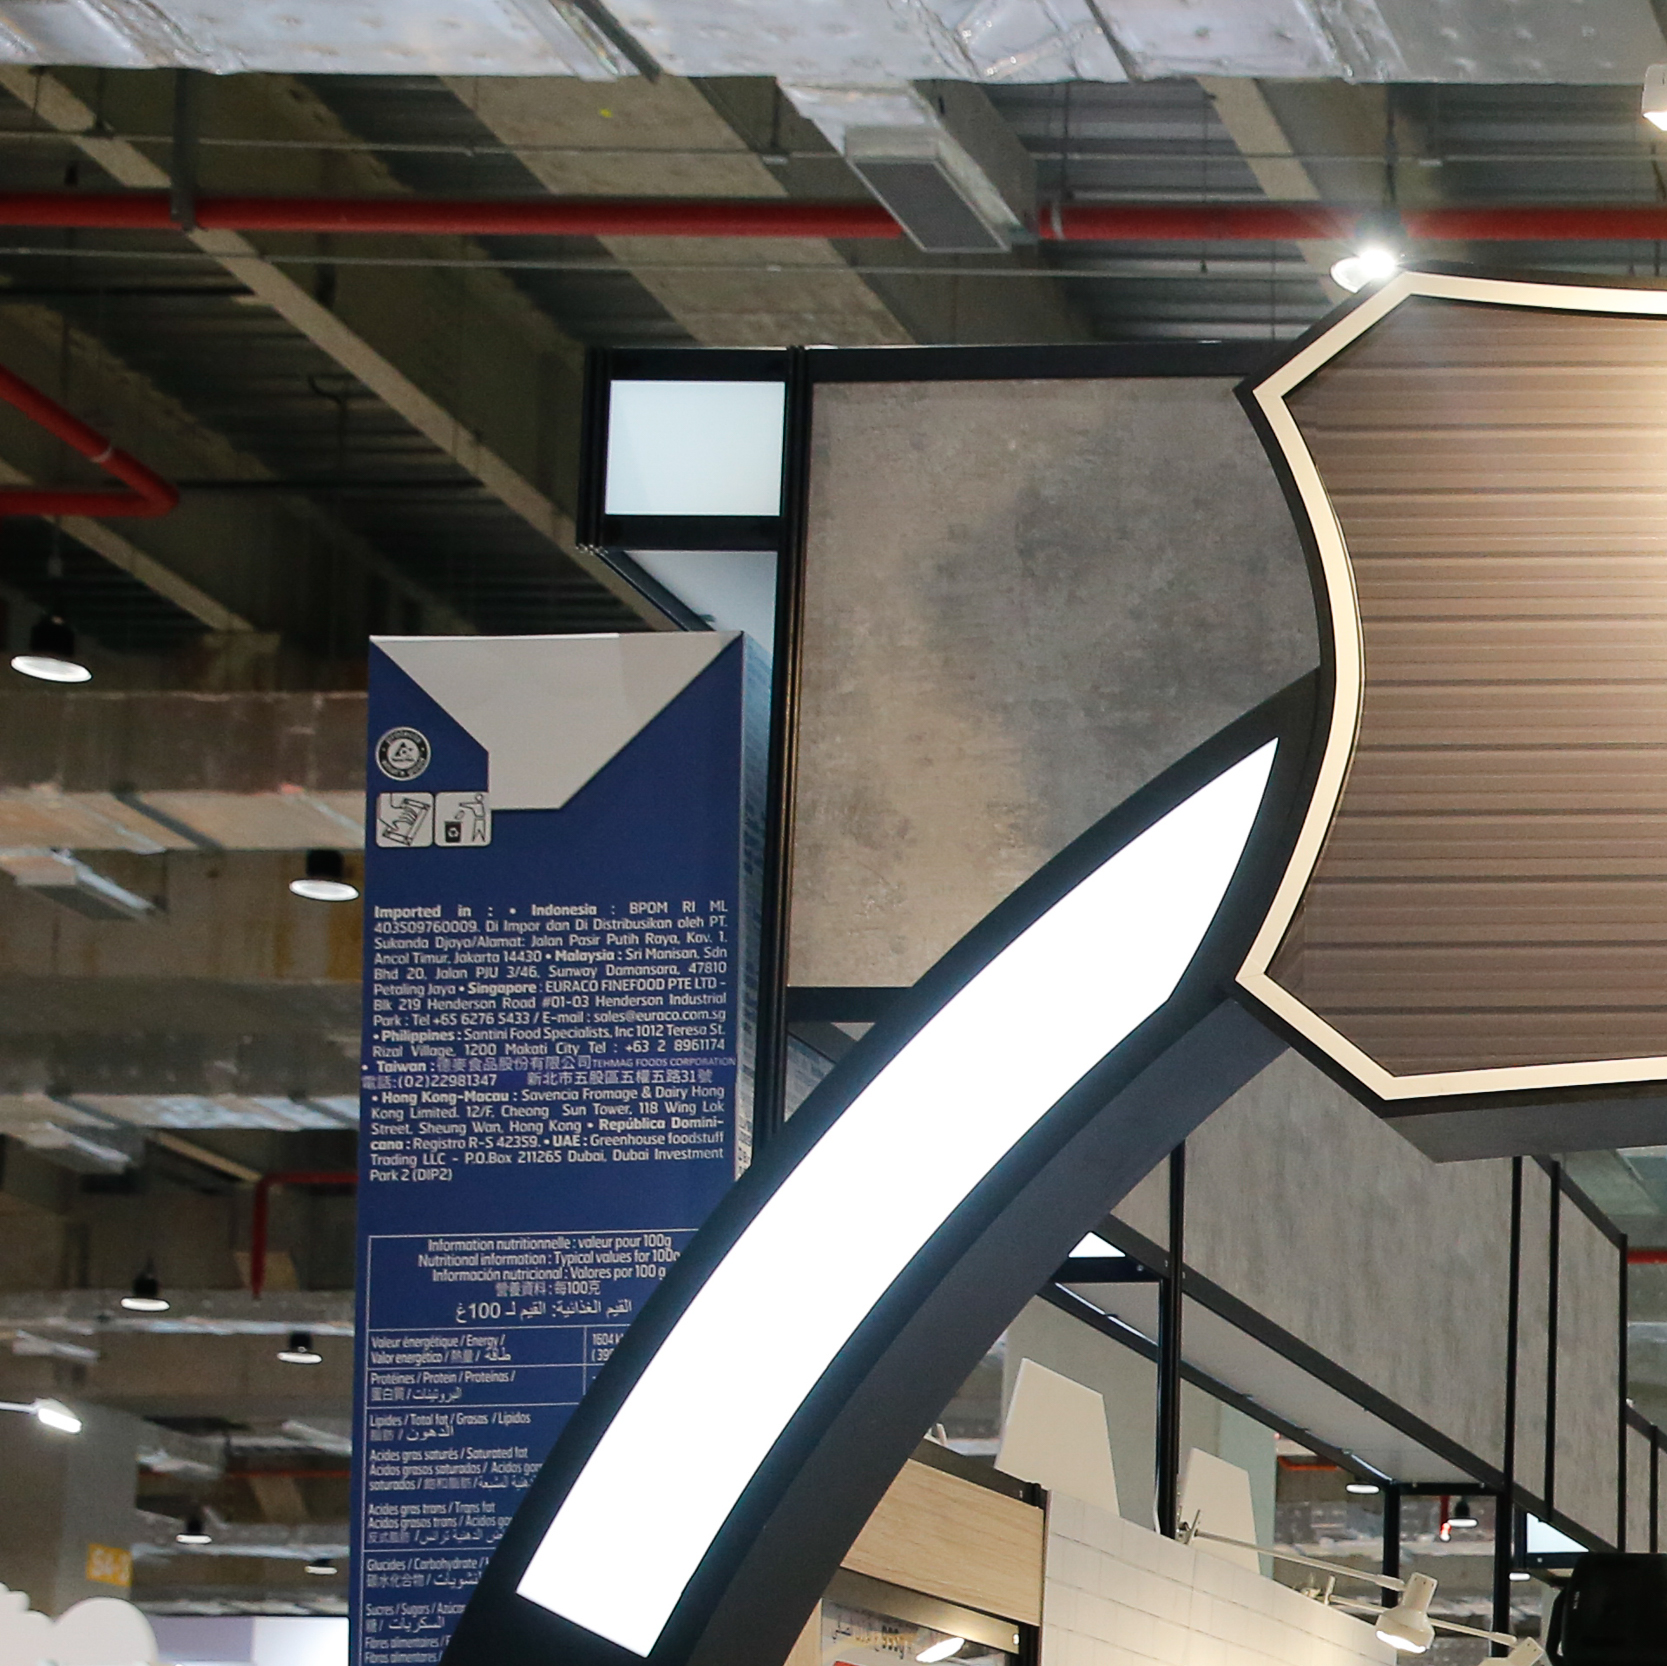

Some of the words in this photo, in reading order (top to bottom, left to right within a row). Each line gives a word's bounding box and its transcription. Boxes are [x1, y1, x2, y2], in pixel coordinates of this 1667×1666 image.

[374, 905, 441, 921] Imported
[531, 902, 597, 915] Indonesia
[592, 916, 672, 929] Distribusikan
[374, 936, 429, 948] Sukanda
[453, 949, 500, 962] Jakarta
[554, 948, 615, 963] Malaysia
[373, 982, 425, 998] Petaling
[467, 980, 537, 996] Singapore
[600, 978, 665, 991] FINEFOOD
[426, 996, 496, 1009] Henderson
[594, 993, 663, 1006] Henderson
[668, 992, 726, 1004] Industrial
[380, 1028, 455, 1044] Philippines
[421, 1088, 509, 1105] Kong-Macau
[521, 1087, 579, 1100] Savencia
[598, 1116, 665, 1132] República
[412, 1135, 466, 1151] Registro
[589, 1132, 665, 1145] Greenhouse
[667, 1131, 724, 1143] foodstuff
[654, 1146, 724, 1159] Investment
